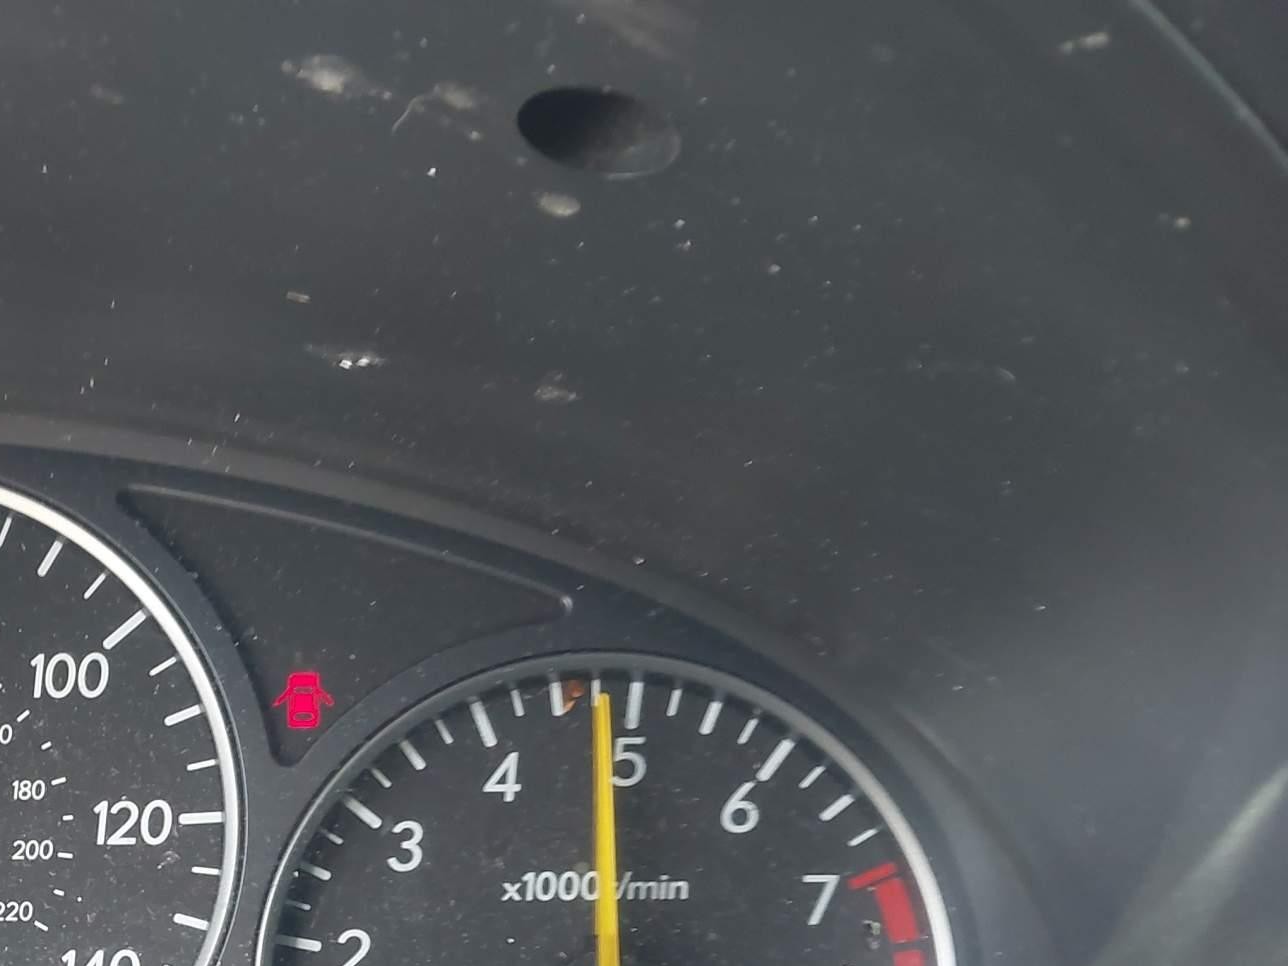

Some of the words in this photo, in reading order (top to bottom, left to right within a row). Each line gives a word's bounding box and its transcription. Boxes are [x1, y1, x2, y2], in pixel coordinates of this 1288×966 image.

[30, 652, 110, 699] 100
[482, 751, 522, 802] 4
[608, 736, 648, 787] 5
[12, 780, 46, 801] 180
[720, 781, 760, 833] 6
[92, 799, 173, 846] 120
[386, 820, 424, 873] 3
[12, 840, 54, 861] 200
[802, 874, 841, 926] 7
